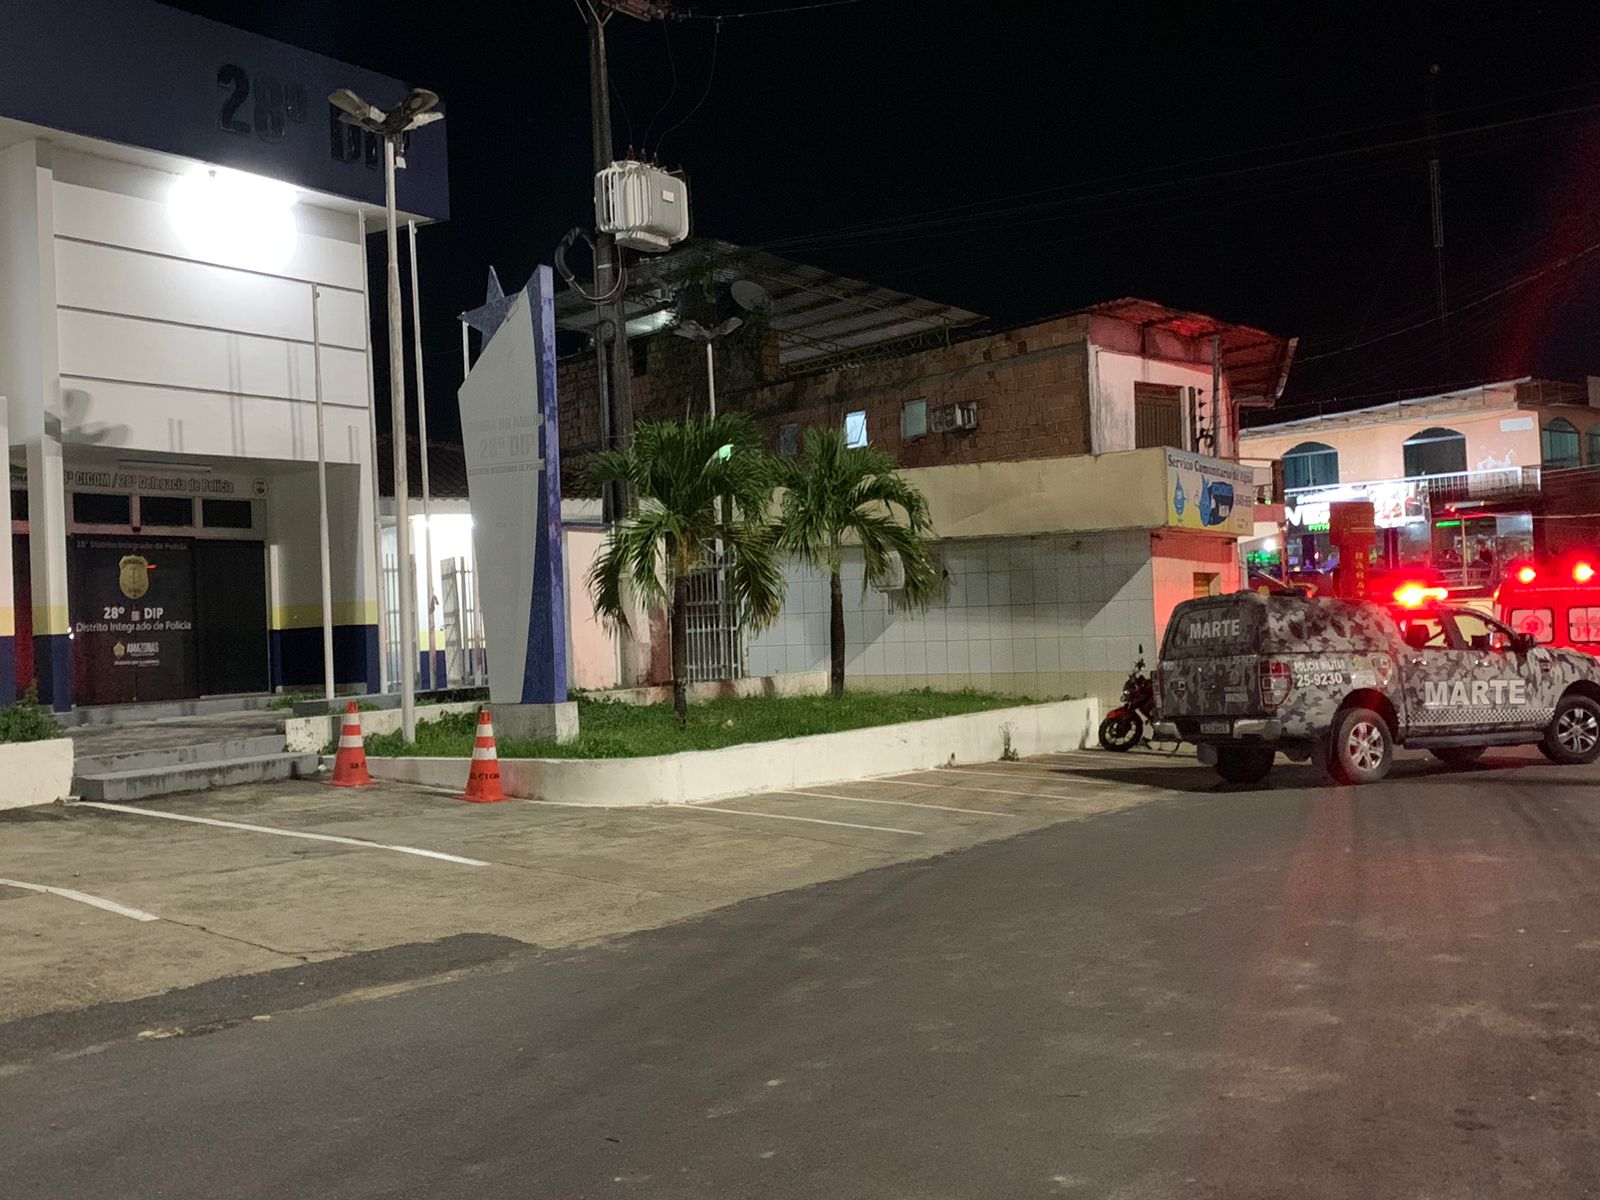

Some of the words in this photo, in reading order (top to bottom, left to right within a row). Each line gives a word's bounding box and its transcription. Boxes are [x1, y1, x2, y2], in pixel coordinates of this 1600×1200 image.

[75, 471, 111, 487] CICOM
[138, 475, 187, 491] Delegacia
[144, 607, 164, 619] DIP
[76, 622, 108, 633] Distrito
[110, 621, 151, 633] Integrado
[153, 621, 164, 631] de
[1189, 619, 1240, 639] MARTE
[1296, 672, 1343, 687] 25-9230
[1424, 680, 1526, 706] MARTE
